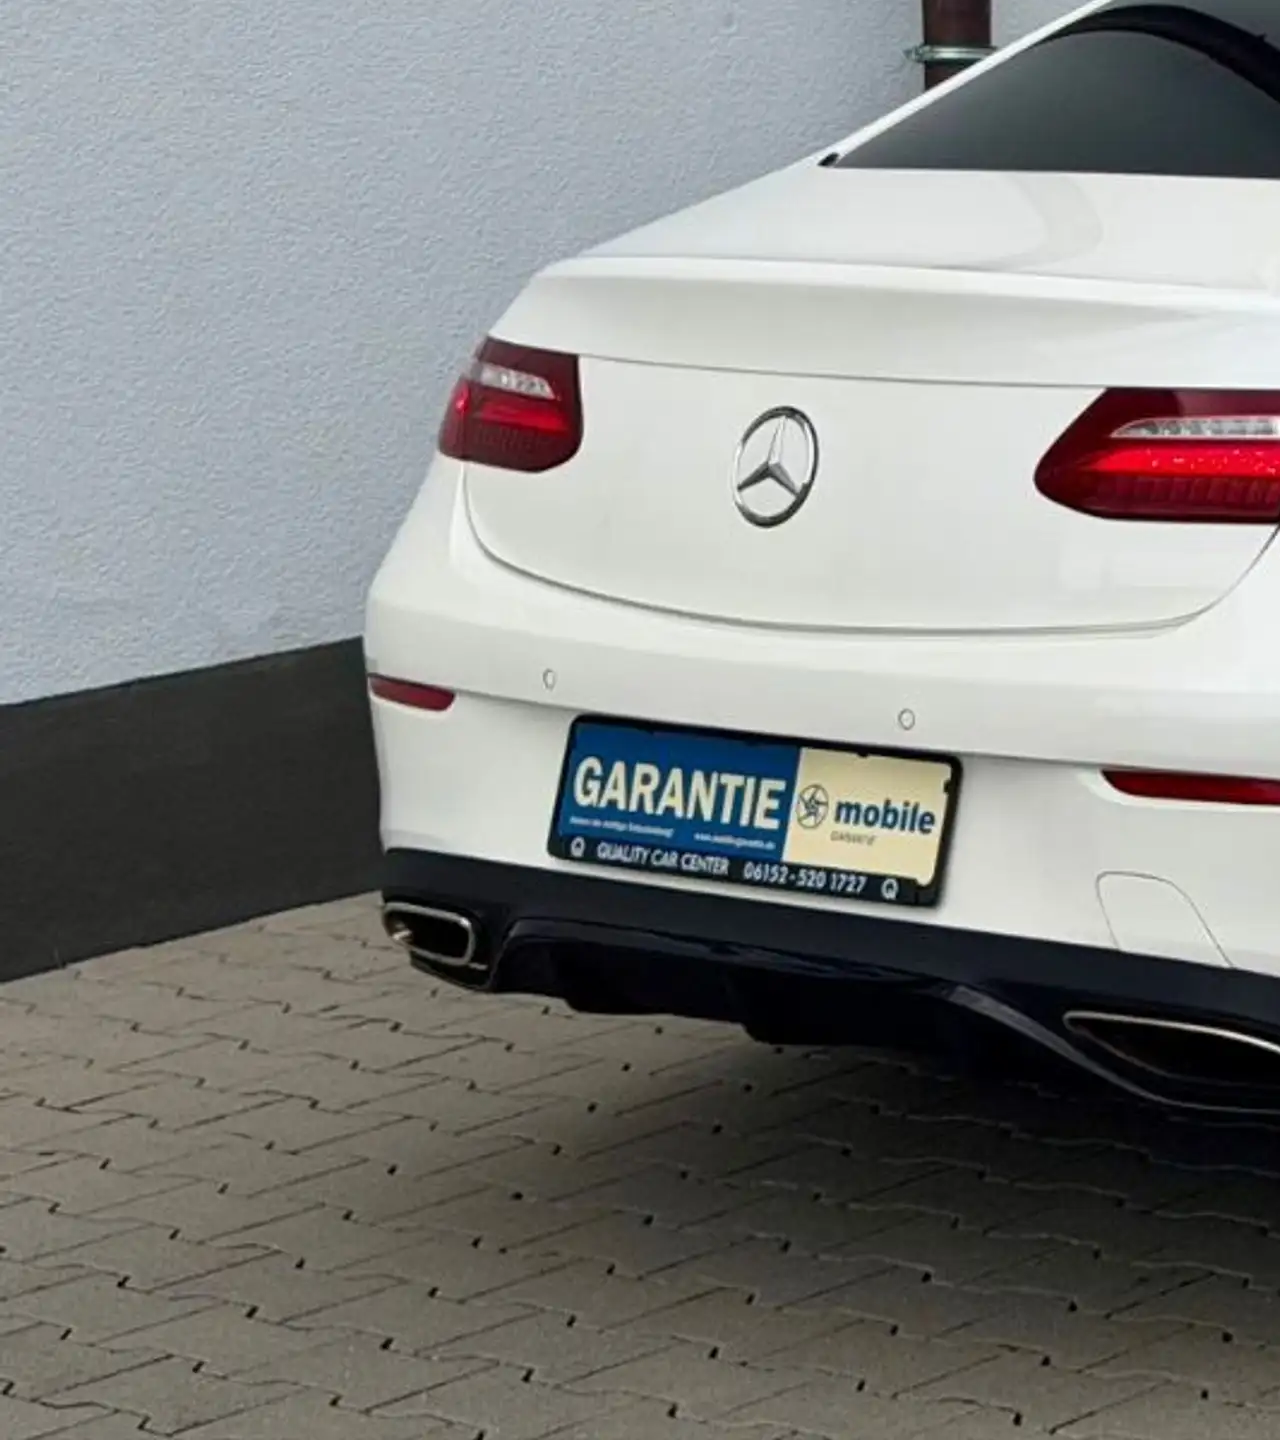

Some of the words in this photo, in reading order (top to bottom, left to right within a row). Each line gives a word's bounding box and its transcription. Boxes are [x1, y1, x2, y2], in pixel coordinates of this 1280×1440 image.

[573, 755, 786, 830] GARANTIE
[834, 797, 936, 835] mobile
[596, 840, 650, 865] QUALITY
[650, 847, 679, 869] CAR
[680, 851, 730, 876] CENTER
[829, 872, 867, 894] 1727
